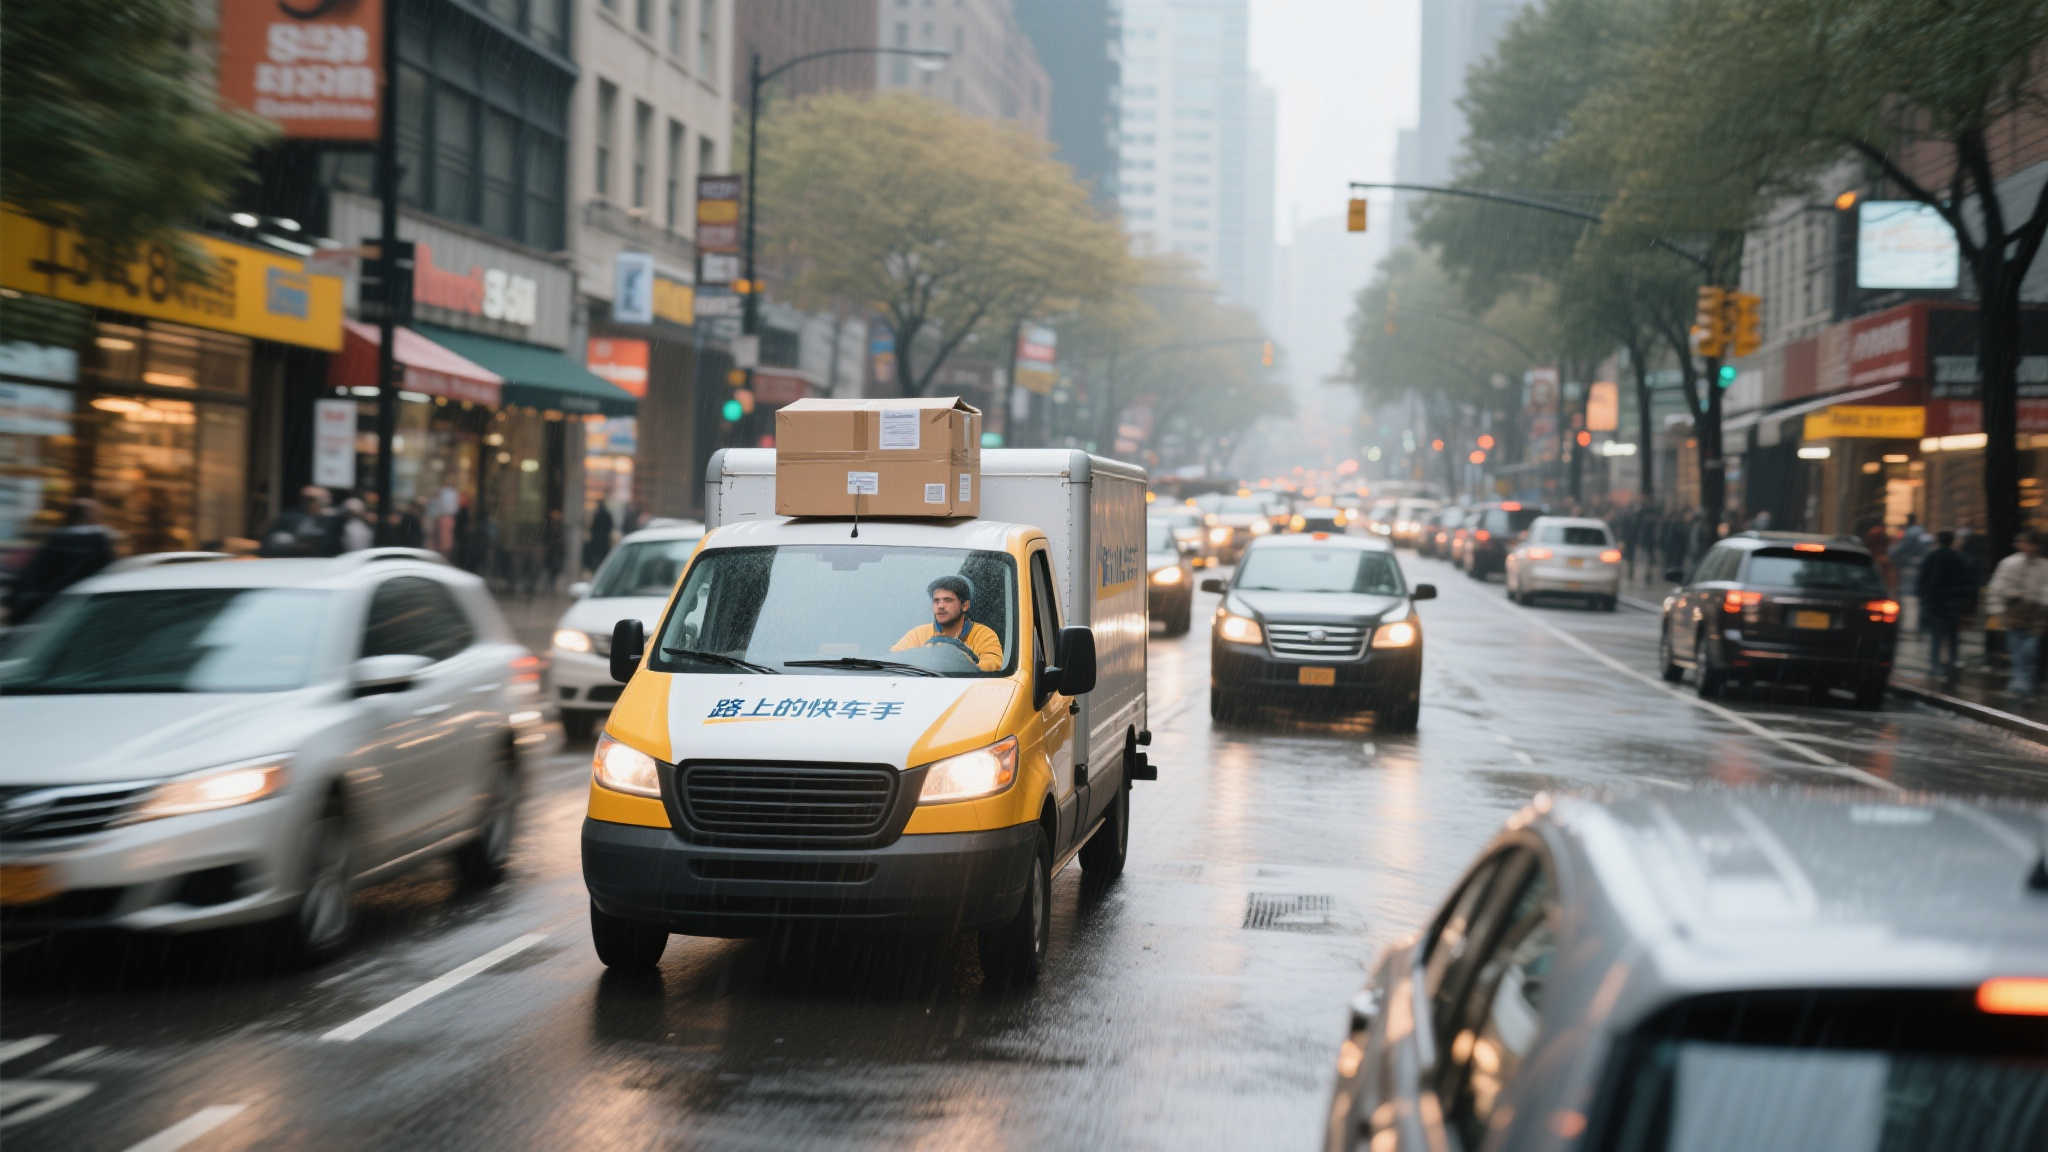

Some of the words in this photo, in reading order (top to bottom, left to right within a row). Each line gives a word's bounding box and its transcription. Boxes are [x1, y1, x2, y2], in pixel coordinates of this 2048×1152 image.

[707, 697, 904, 720] 路上的快车手
